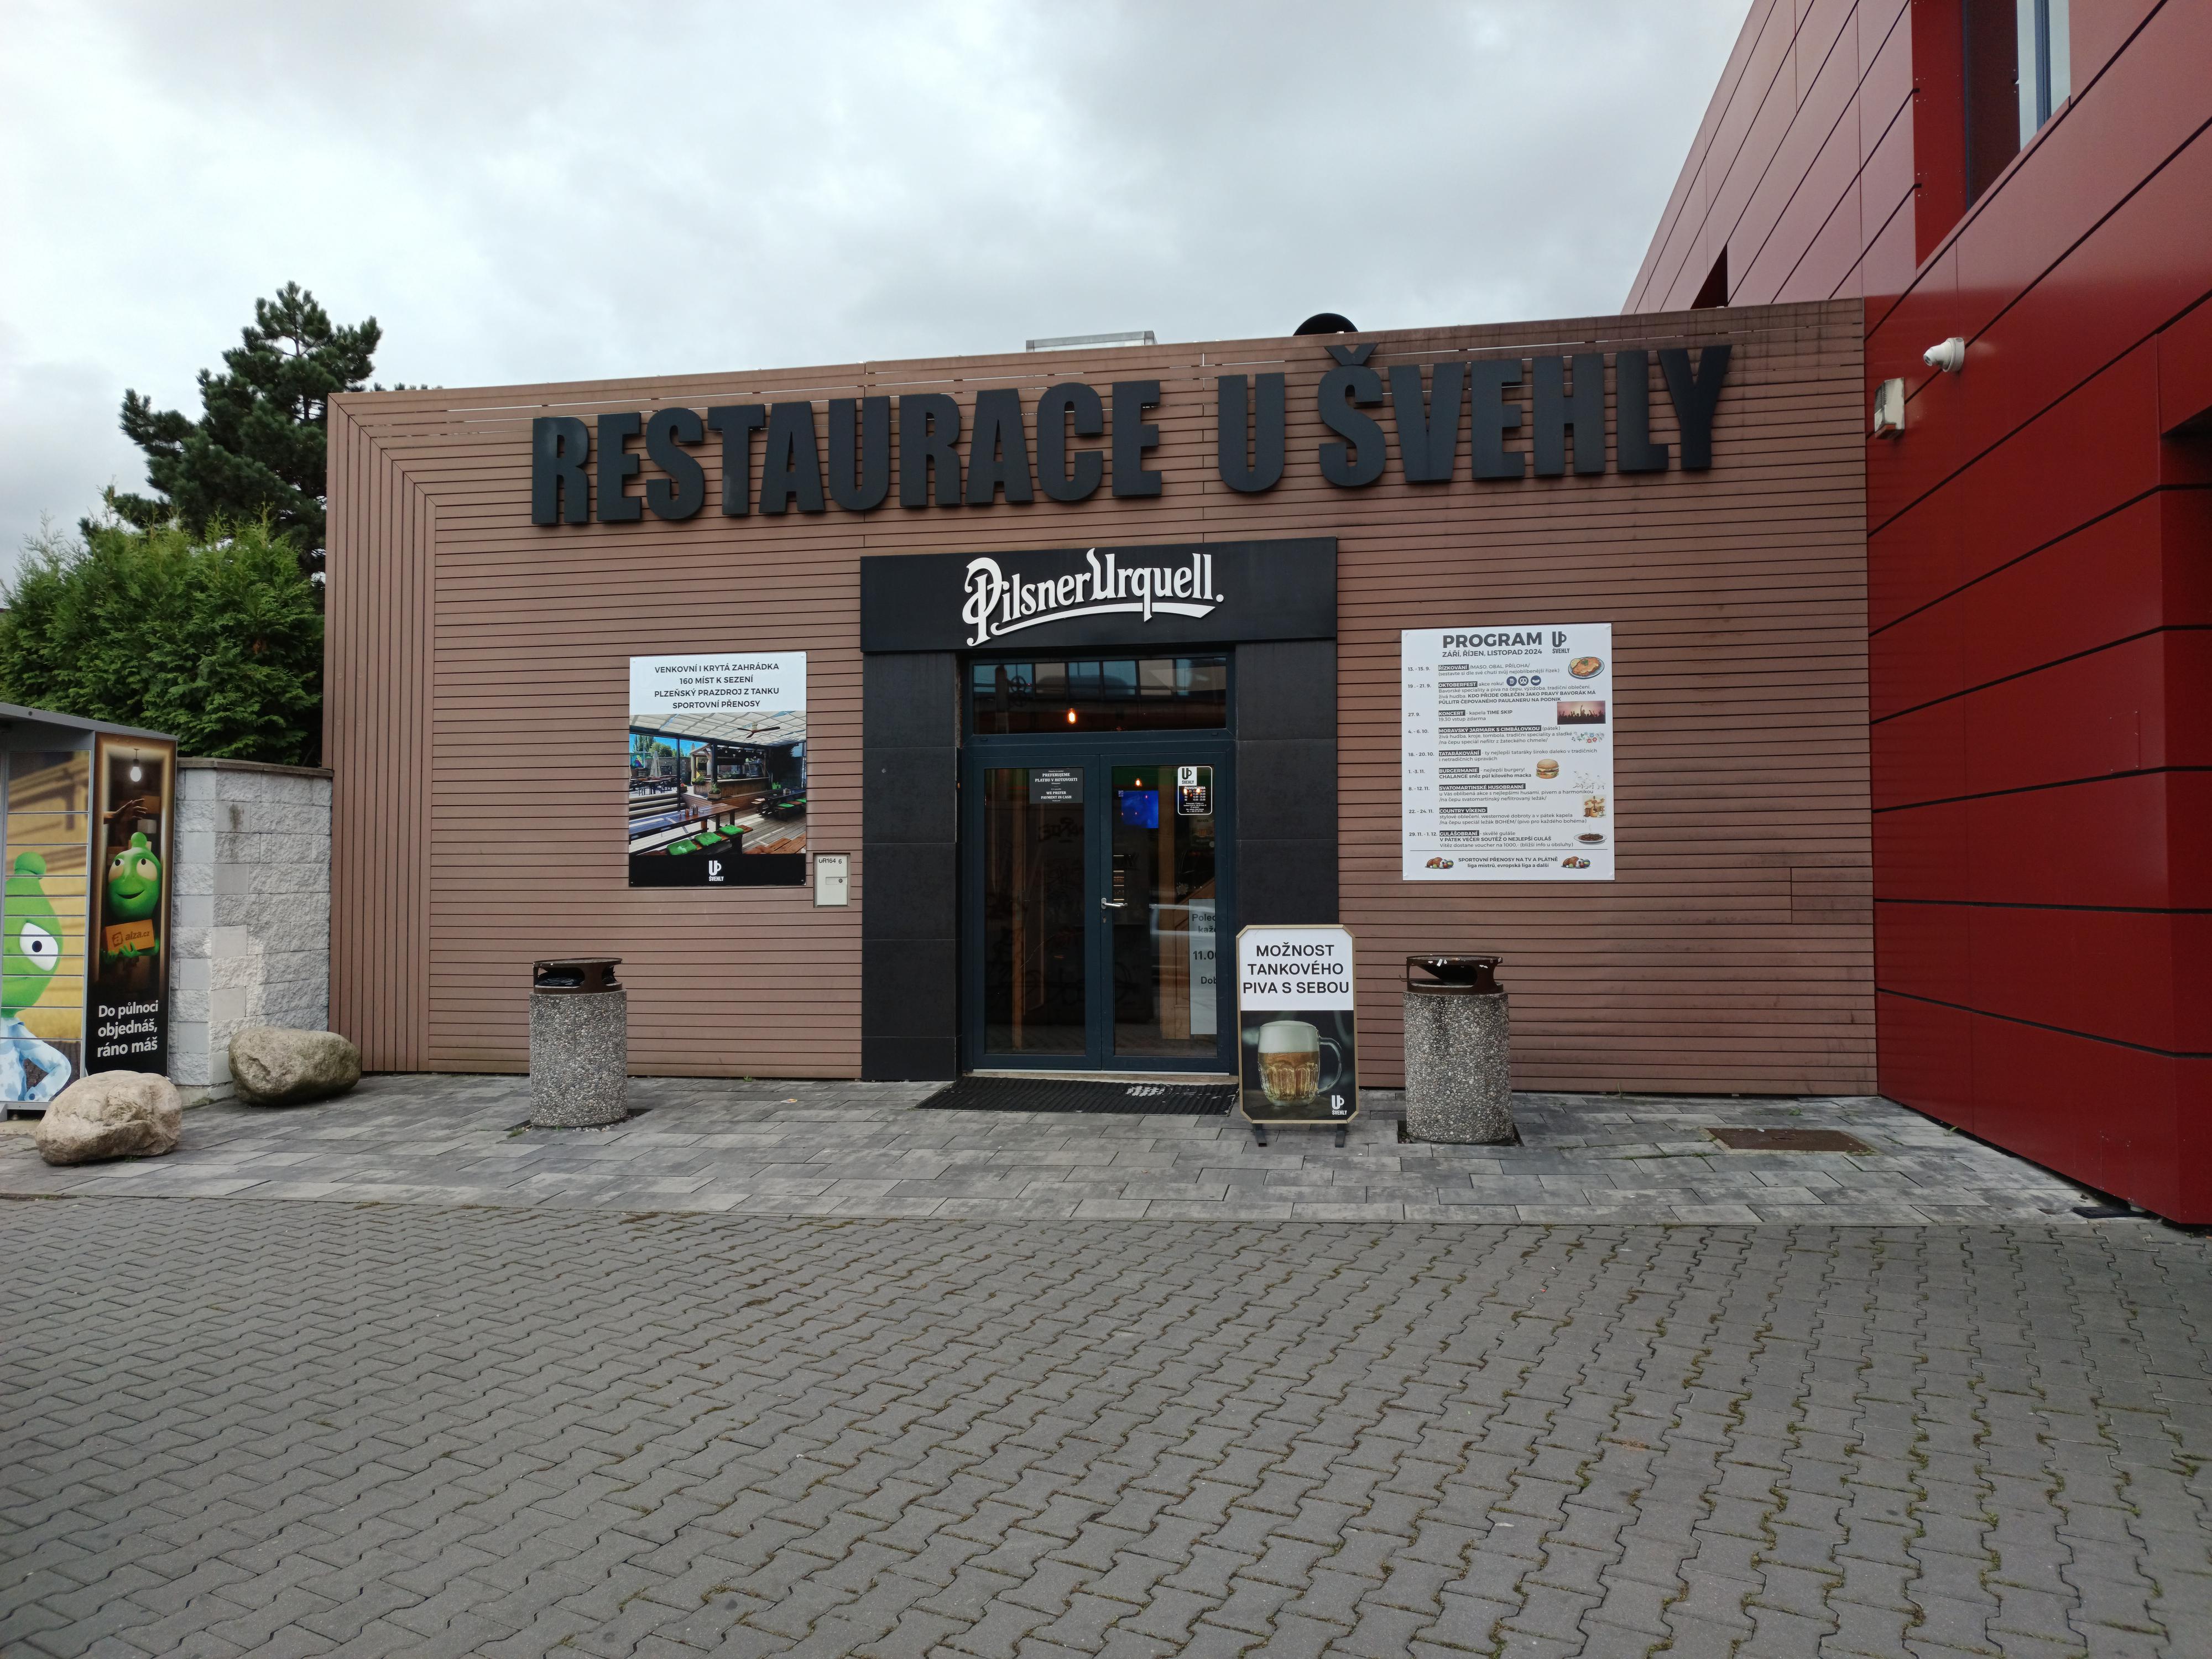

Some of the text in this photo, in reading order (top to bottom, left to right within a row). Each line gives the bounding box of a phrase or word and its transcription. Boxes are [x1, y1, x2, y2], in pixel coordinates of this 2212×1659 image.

[531, 343, 1733, 525] RESTAURACE U ŠVEHLY
[962, 557, 1091, 646] Pilsner
[1443, 632, 1542, 648] PROGRAM
[1442, 649, 1461, 658] ZÁŘÍ,
[1463, 649, 1485, 658] ŘÍJEN,
[655, 664, 697, 673] VENKOVNÍ
[703, 664, 730, 672] KRYTÁ
[732, 662, 779, 671] ZAHRÁDKA
[695, 676, 714, 684] MÍST
[723, 675, 753, 684] SEZENÍ
[654, 688, 696, 697] PLZEŇSKÝ
[672, 698, 760, 708] SPORTOVNÍ PŘENOSY
[1198, 925, 1215, 933] kaž
[125, 930, 150, 941] alza.cz
[1193, 951, 1215, 960] 11.0
[1256, 942, 1335, 957] MOŽNOST
[1248, 961, 1344, 975] TANKOVÉHO
[1243, 982, 1349, 994] PIVA S SEBOU
[98, 1000, 159, 1019] Do půlnoci
[98, 1019, 158, 1039] objednáš,
[97, 1036, 158, 1057] ráno máš
